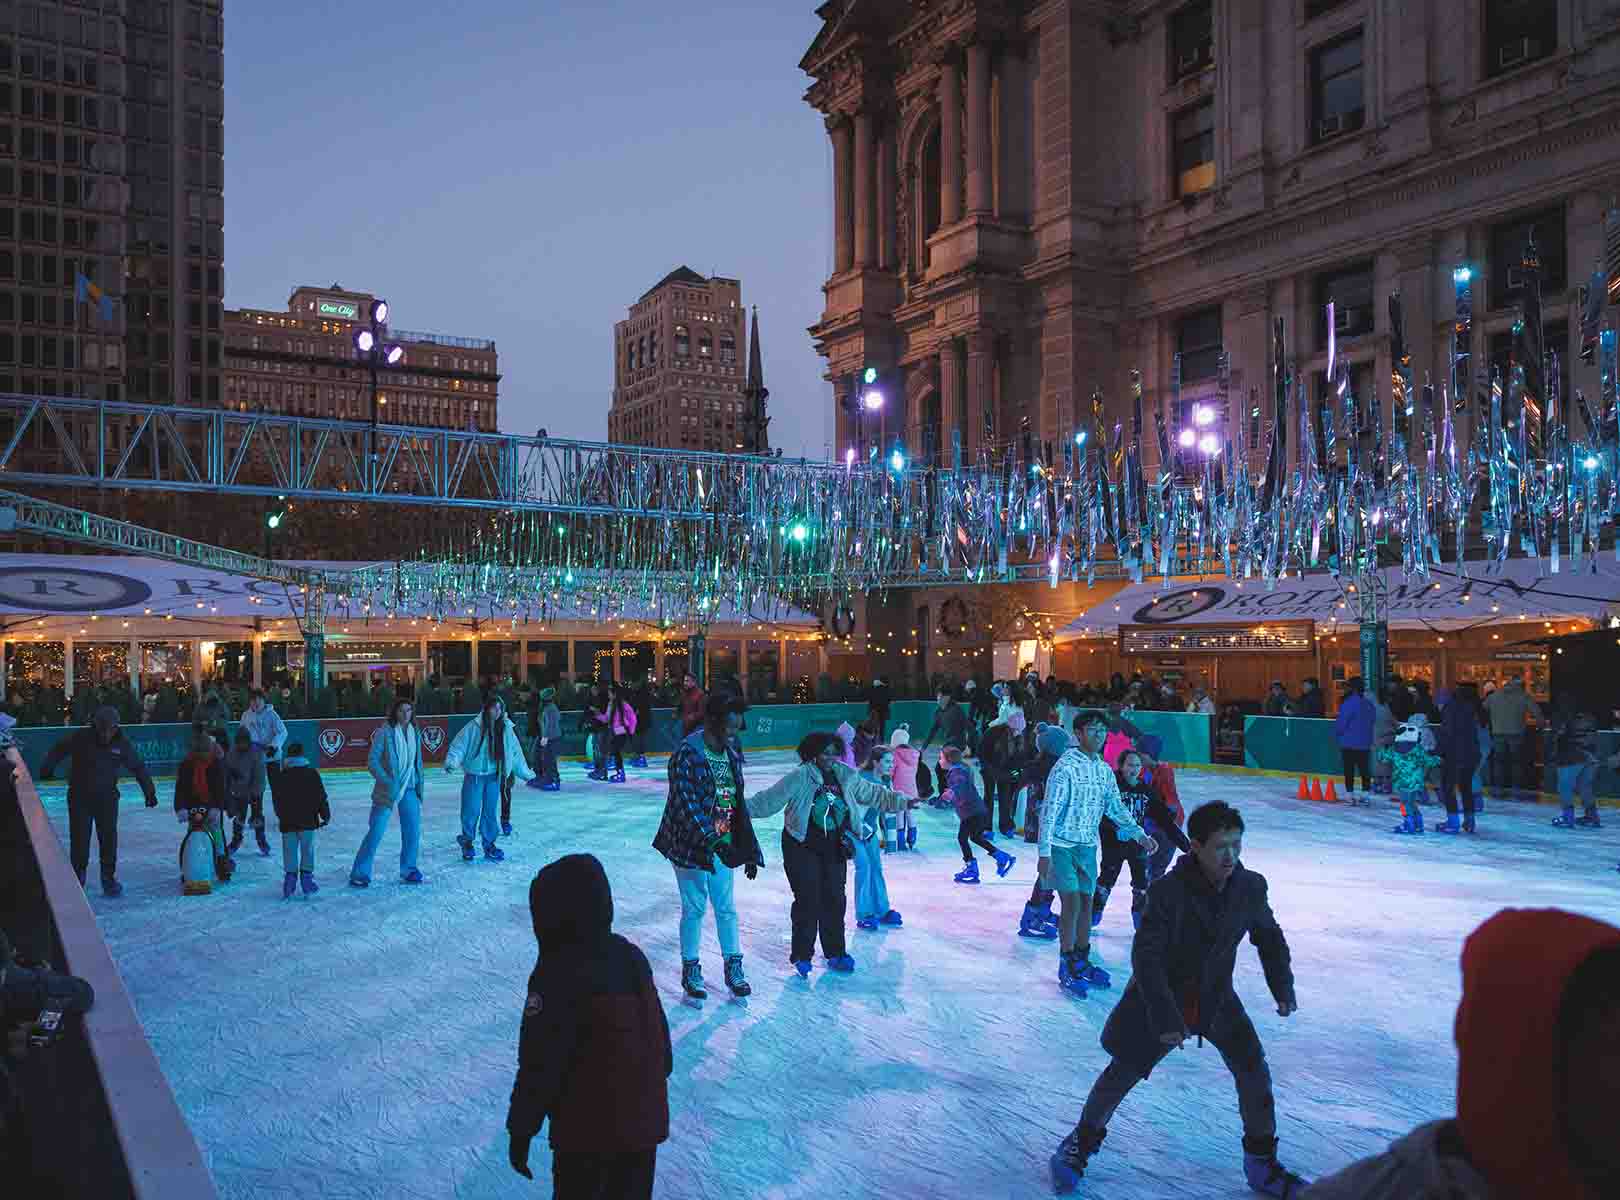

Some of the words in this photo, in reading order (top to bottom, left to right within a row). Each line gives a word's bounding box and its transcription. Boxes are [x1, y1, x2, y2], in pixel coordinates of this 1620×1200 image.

[320, 303, 337, 313] One
[338, 304, 354, 318] City
[24, 577, 97, 598] R
[1160, 600, 1193, 612] R
[1159, 635, 1207, 648] SKATE
[1210, 635, 1284, 648] RENTALS
